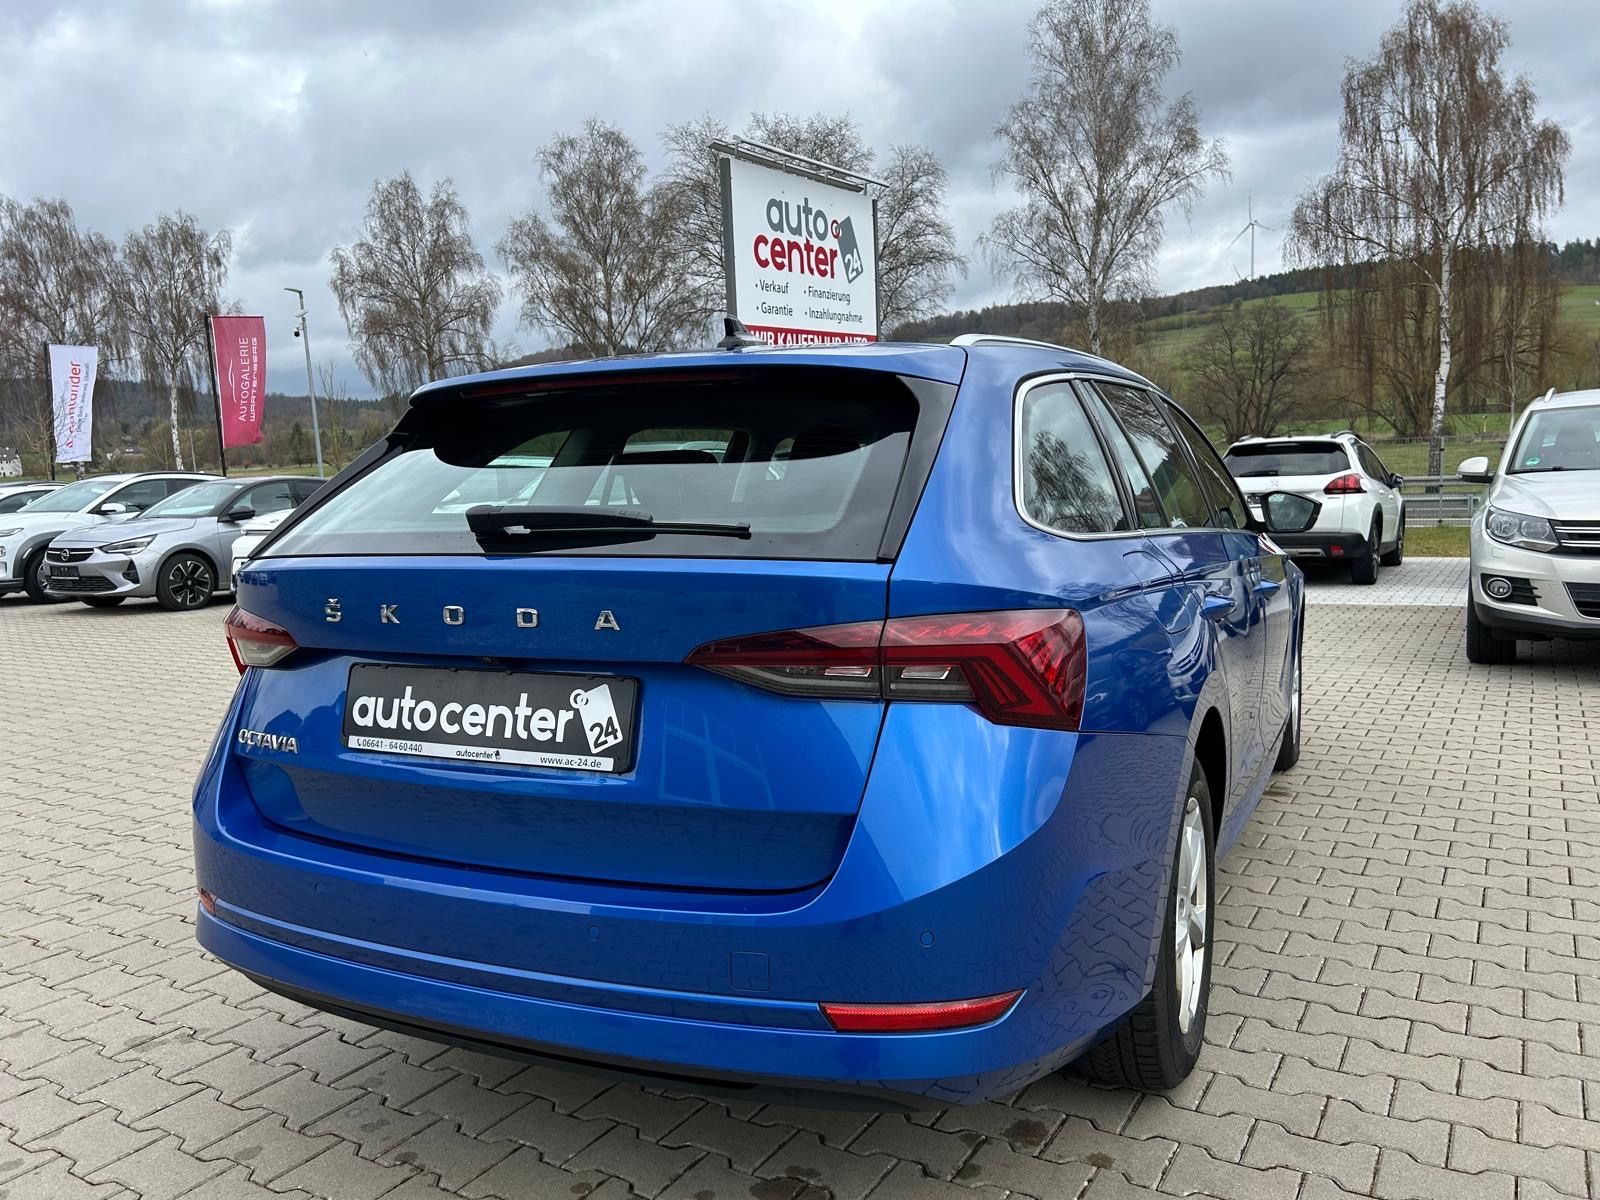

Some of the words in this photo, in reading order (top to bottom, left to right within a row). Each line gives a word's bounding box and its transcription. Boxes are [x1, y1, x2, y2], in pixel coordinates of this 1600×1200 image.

[766, 197, 828, 241] auto
[753, 234, 838, 279] center
[845, 248, 862, 279] 24
[759, 279, 789, 294] Verkauf
[808, 285, 851, 305] Finanzierung
[760, 302, 793, 316] Garantie
[809, 307, 863, 324] Inzahlungnahme
[238, 336, 250, 422] AUTOGALERIE
[323, 597, 621, 632] ŠKODA
[352, 685, 574, 743] autocenter
[588, 715, 619, 749] 24
[237, 728, 298, 754] OCTAVIA
[362, 738, 383, 749] 06641
[455, 748, 494, 759] autocenter
[539, 755, 602, 769] www.ac-24.de
